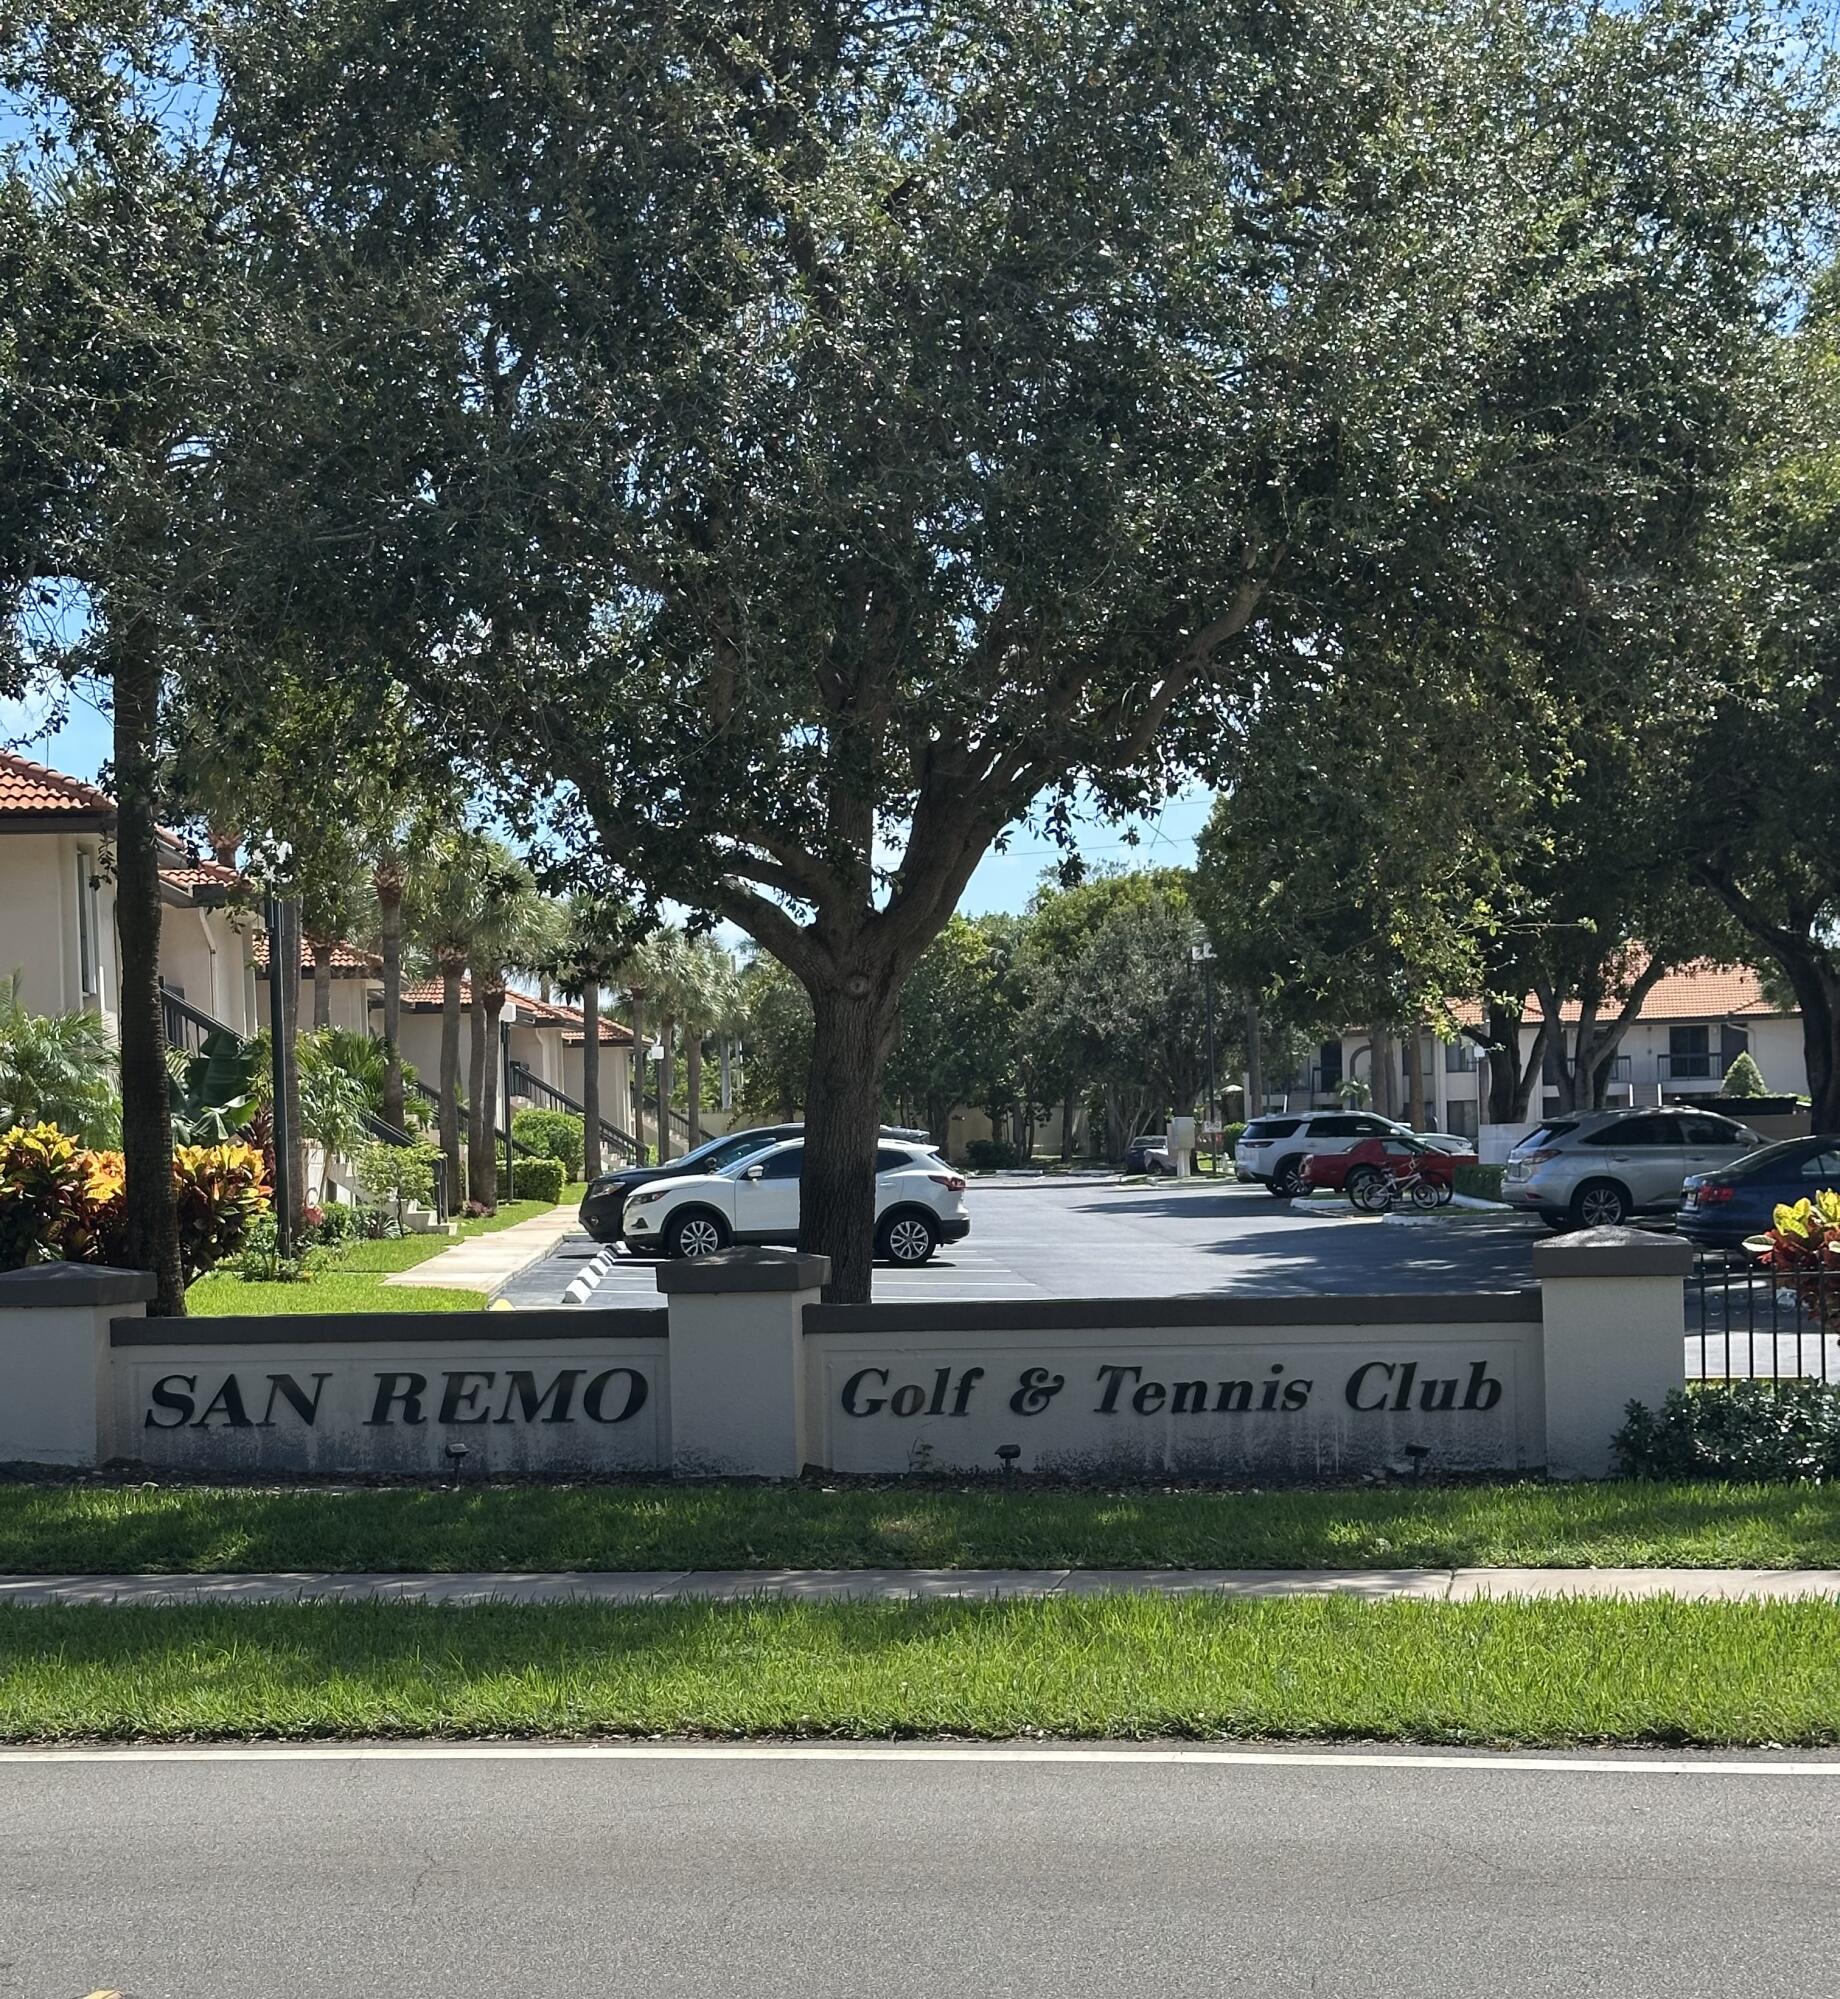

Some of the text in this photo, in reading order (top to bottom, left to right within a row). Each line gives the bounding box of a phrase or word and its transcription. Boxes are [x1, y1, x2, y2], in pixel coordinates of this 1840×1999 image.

[144, 1367, 649, 1429] SAN REMO
[841, 1360, 1503, 1418] Golf & Tennis Club
